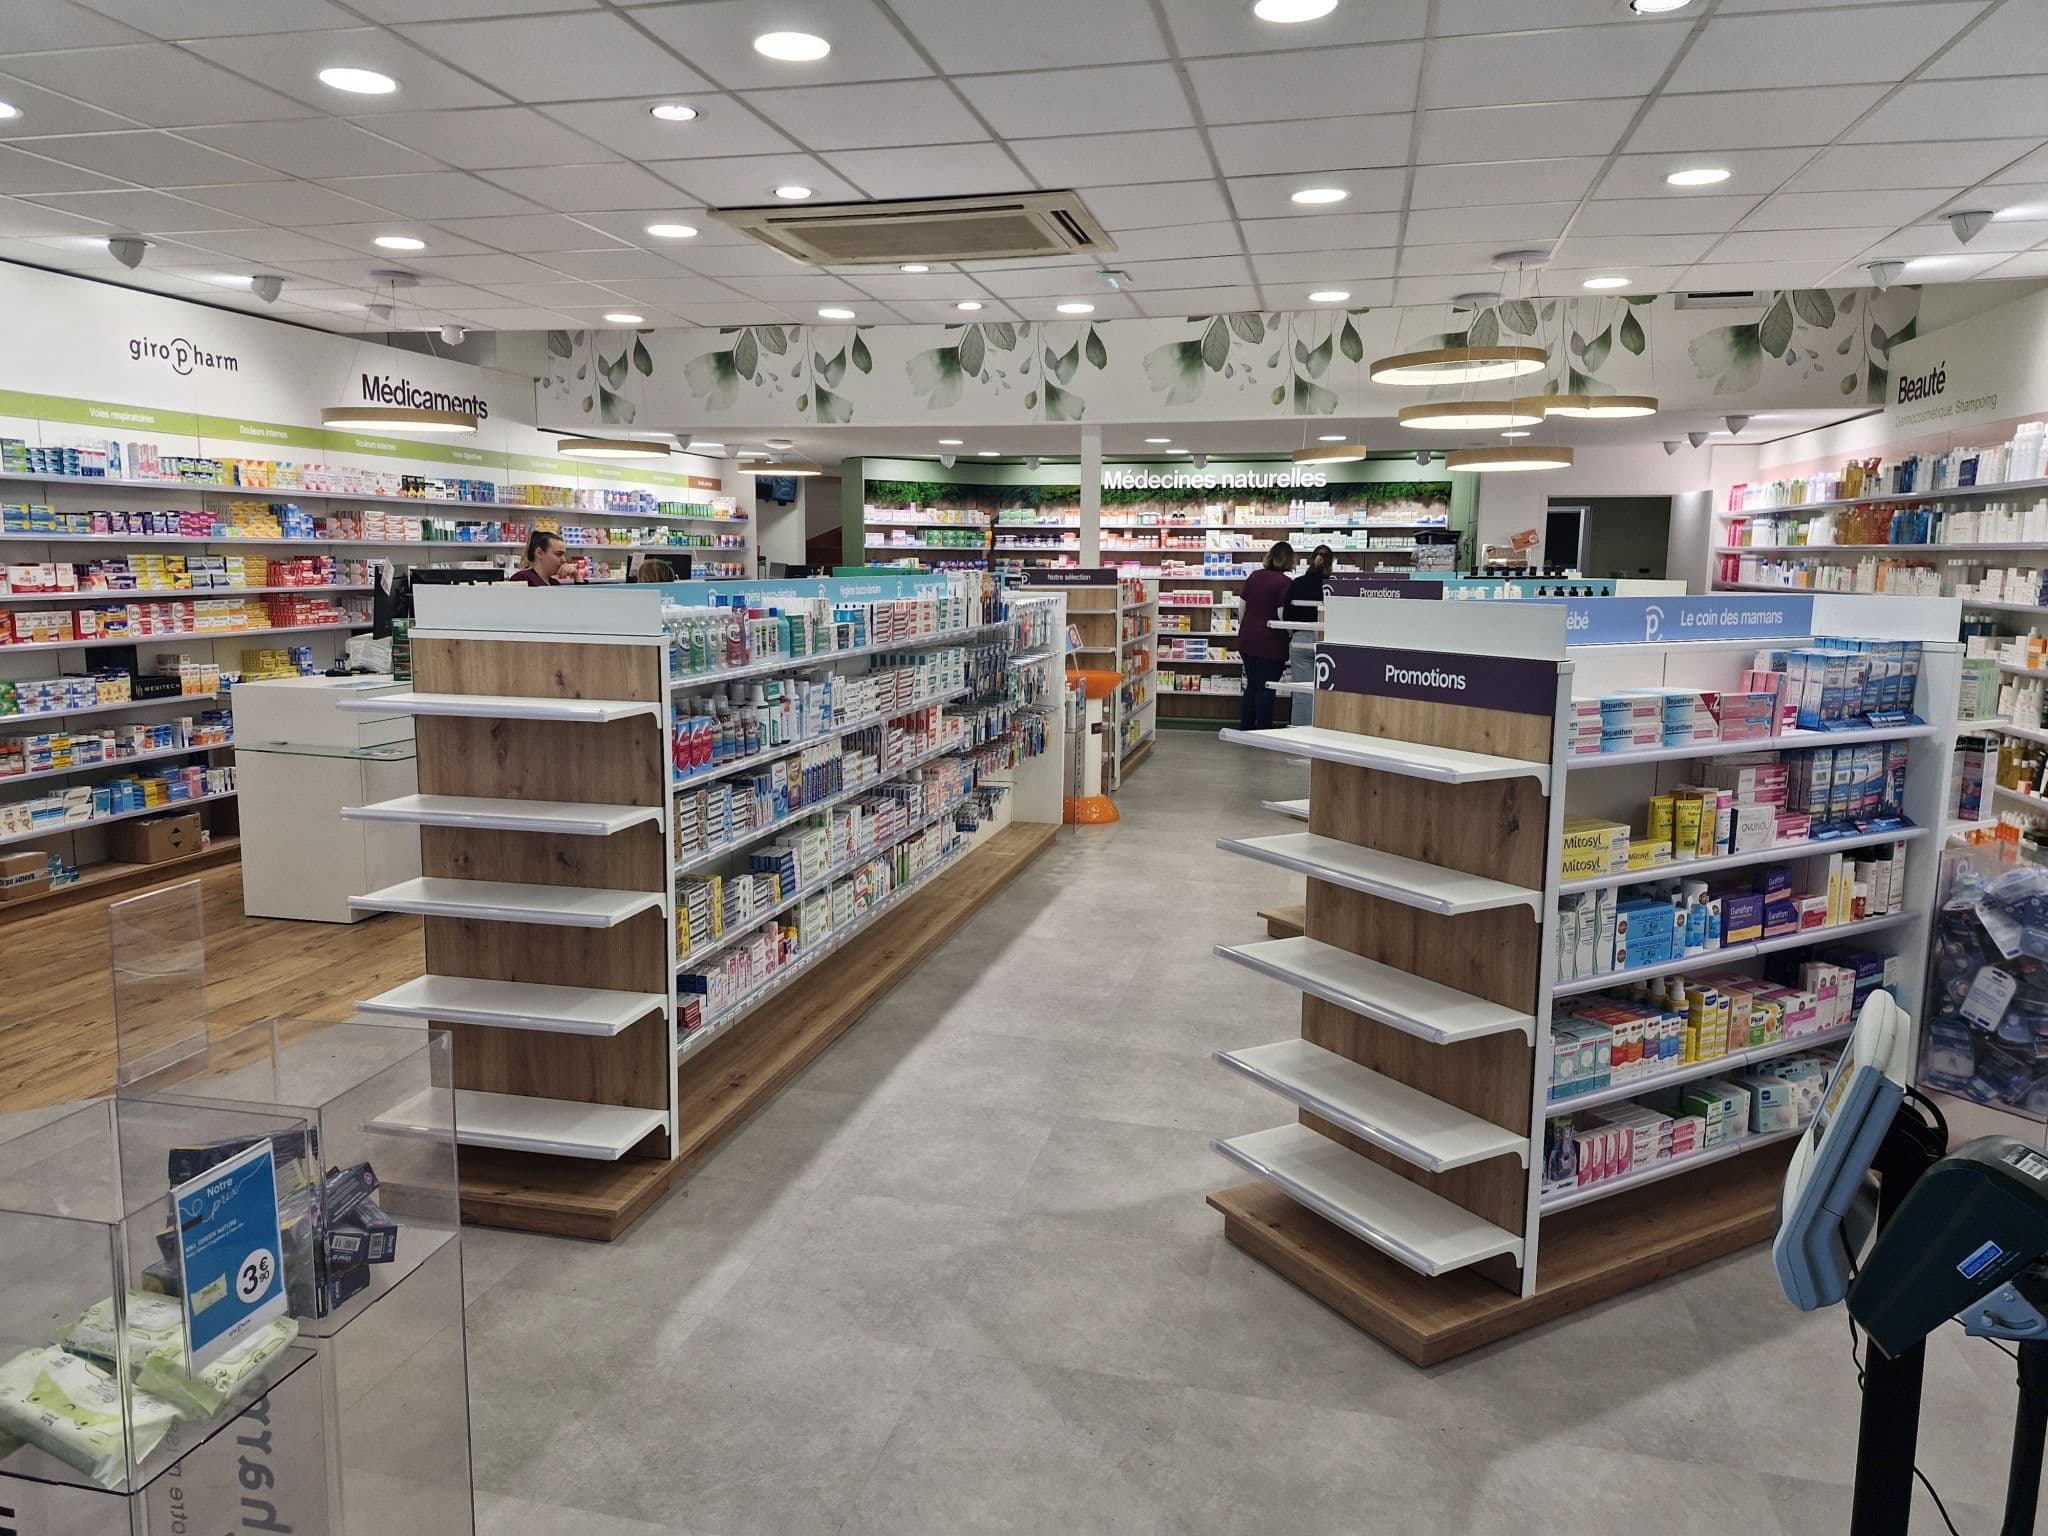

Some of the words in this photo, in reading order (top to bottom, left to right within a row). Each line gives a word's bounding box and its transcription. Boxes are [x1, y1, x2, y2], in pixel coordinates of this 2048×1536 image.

[129, 337, 238, 372] giropharm
[1897, 361, 1946, 404] Beauté
[361, 373, 488, 419] Médicaments
[1955, 393, 1998, 414] Shampoing
[89, 407, 109, 419] Voies
[111, 411, 155, 424] respiratoires
[240, 425, 265, 437] Douleurs
[1103, 469, 1216, 490] Médecines
[1221, 467, 1327, 488] naturelles
[1047, 573, 1063, 581] Notre
[1065, 573, 1091, 581] sélection
[1359, 587, 1401, 599] Promotions
[1566, 610, 1589, 630] ébé
[1680, 610, 1694, 626] Le
[1696, 609, 1721, 626] coin
[1723, 608, 1741, 626] des
[1742, 610, 1783, 625] mamans
[1385, 664, 1466, 690] Promotions
[143, 683, 181, 693] MEDITECH
[1601, 701, 1632, 710] Bepanthen
[1666, 697, 1694, 706] Bepanthen
[1602, 728, 1633, 738] Bepanthen
[1665, 723, 1693, 732] Bepanthen
[1563, 833, 1602, 851] Mitosyl
[1562, 856, 1601, 874] Mitosyl
[1628, 851, 1650, 861] Mitosyl
[206, 1177, 233, 1198] Notre
[197, 1231, 217, 1246] GREEN
[217, 1218, 237, 1234] NATURE
